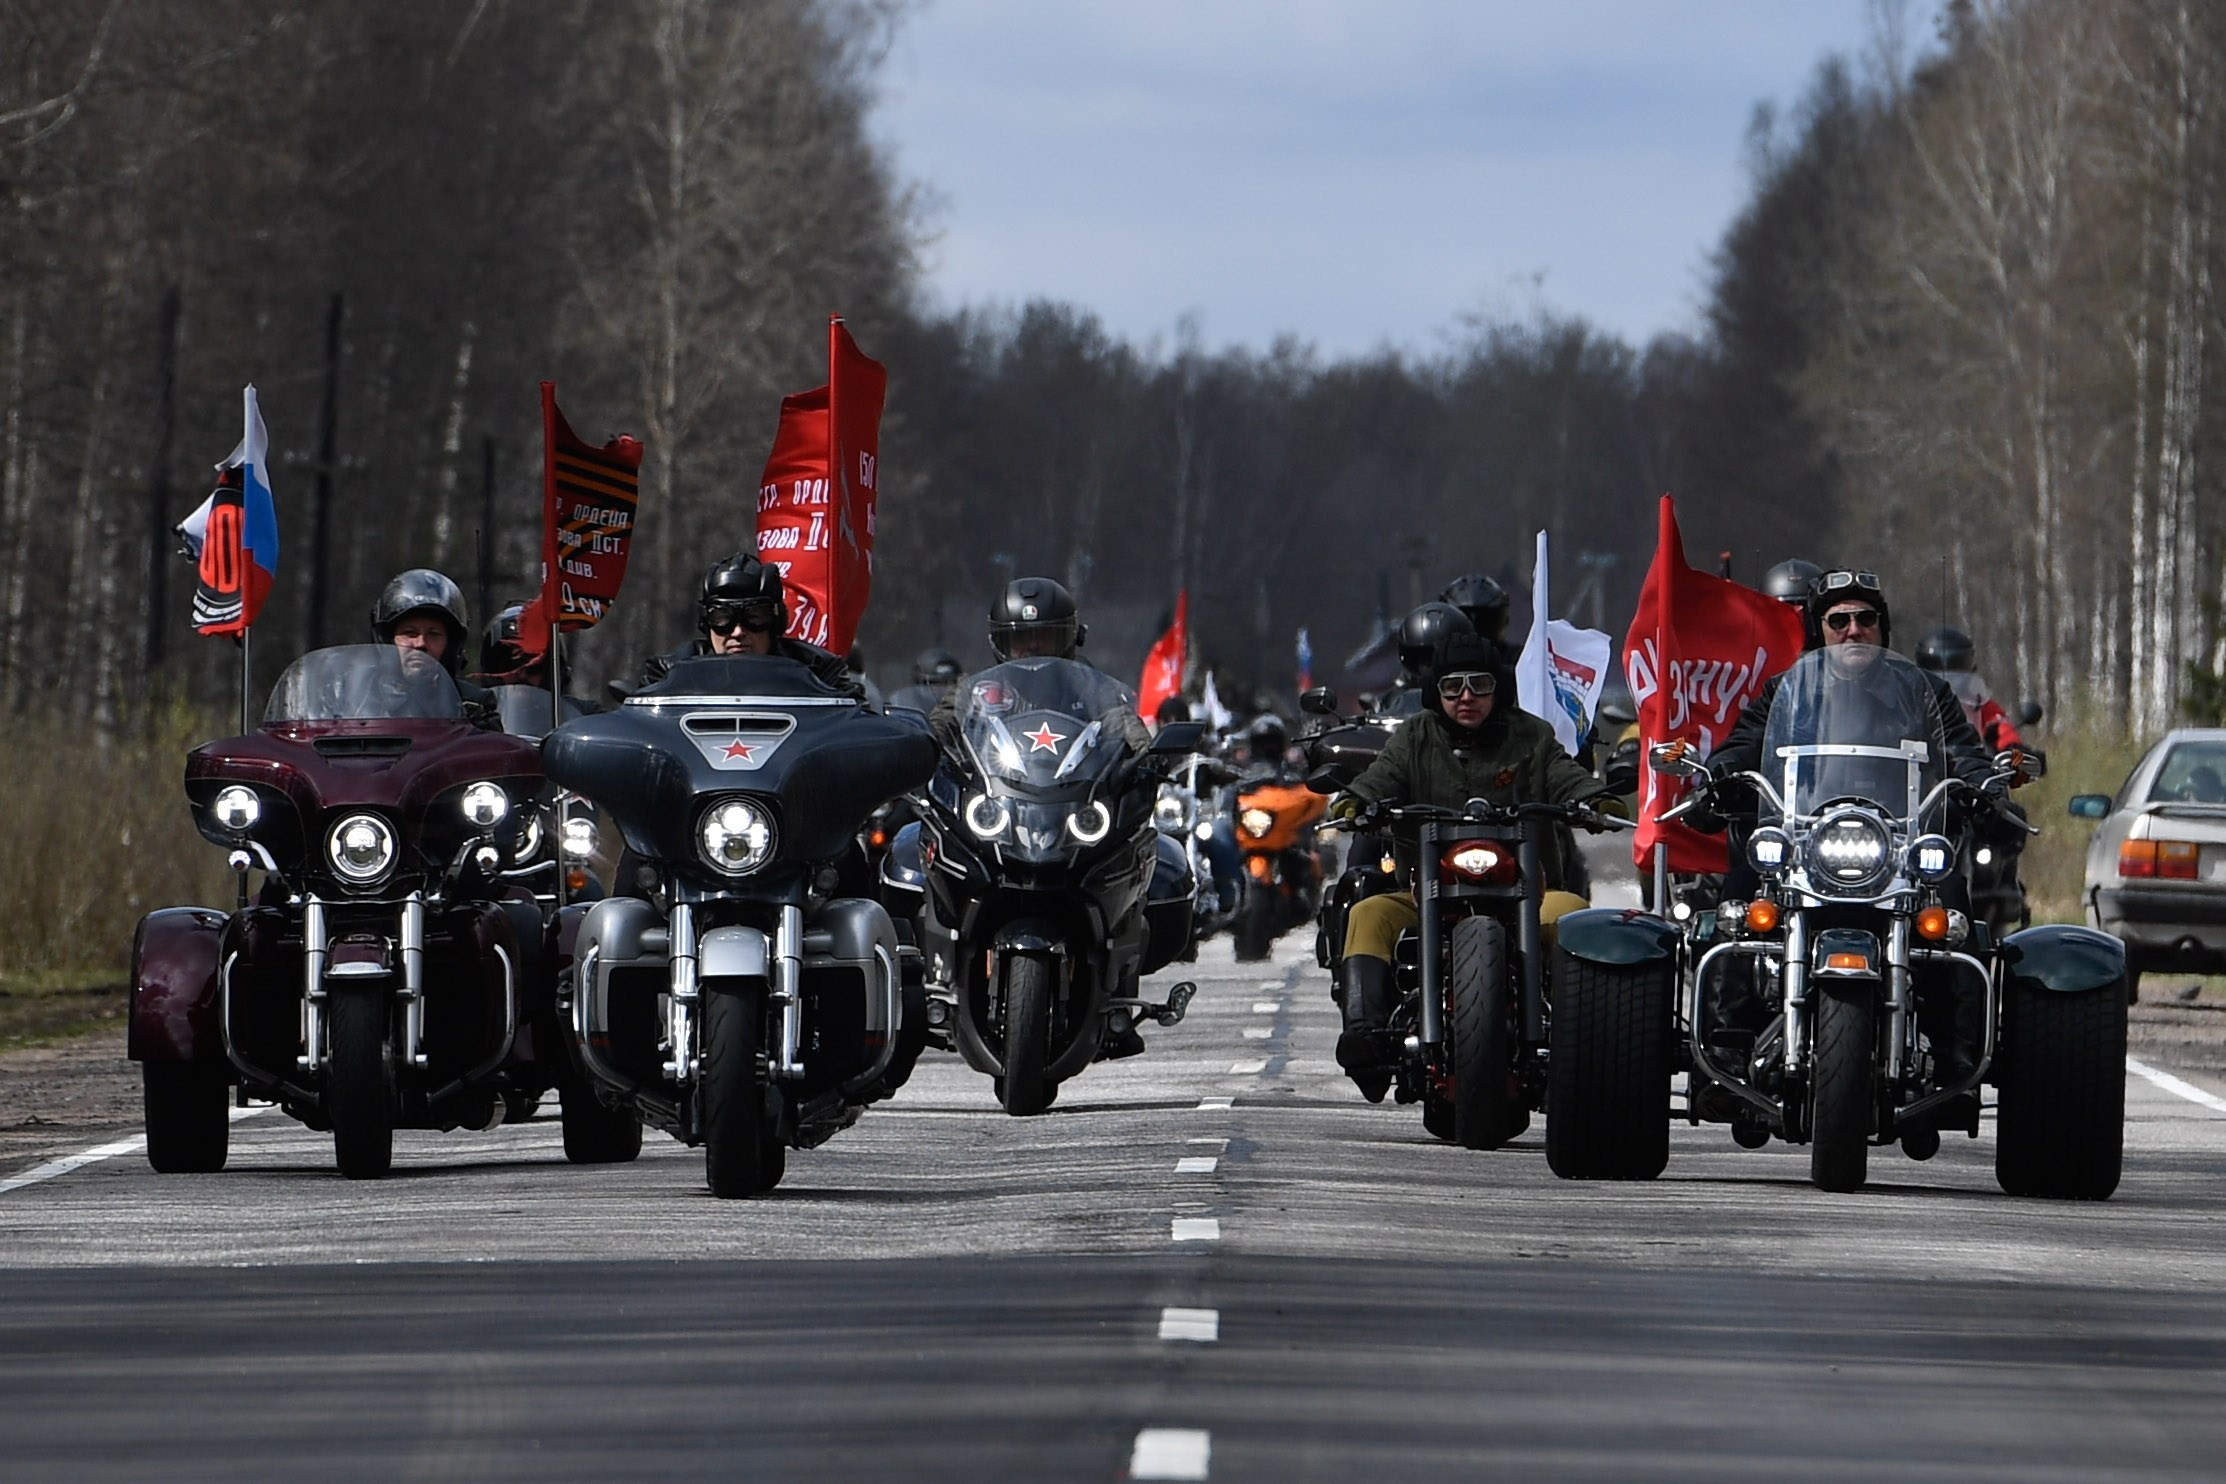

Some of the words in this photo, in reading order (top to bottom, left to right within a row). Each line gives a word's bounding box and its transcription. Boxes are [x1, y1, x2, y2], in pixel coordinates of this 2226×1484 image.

[573, 503, 629, 529] ОРДЕНА
[557, 527, 582, 548] ЗОВА
[561, 582, 575, 612] 9
